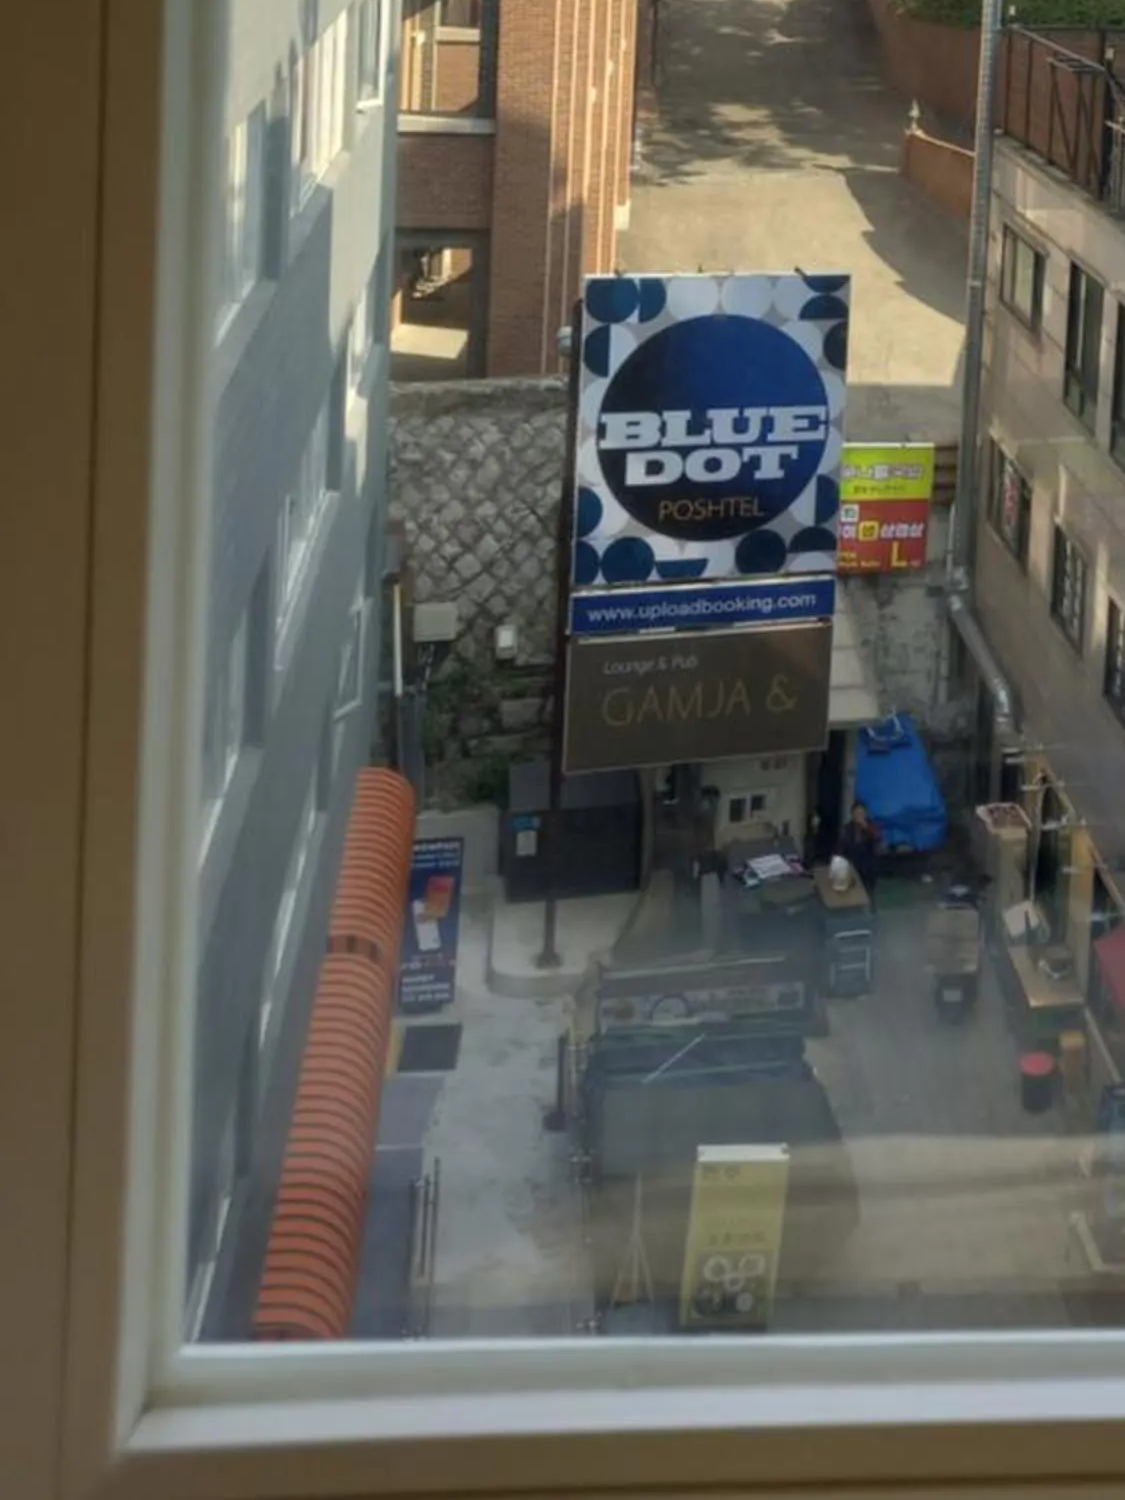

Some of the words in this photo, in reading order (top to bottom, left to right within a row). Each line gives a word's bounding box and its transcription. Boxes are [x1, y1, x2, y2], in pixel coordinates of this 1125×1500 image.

[600, 405, 827, 450] BLUE
[625, 445, 798, 486] DOT
[658, 497, 765, 522] POSHTEL
[587, 593, 817, 622] www.uploadbooking.com
[603, 659, 656, 675] Lounge
[671, 654, 698, 670] Pub
[602, 678, 752, 727] GAMJA
[765, 673, 797, 713] &
